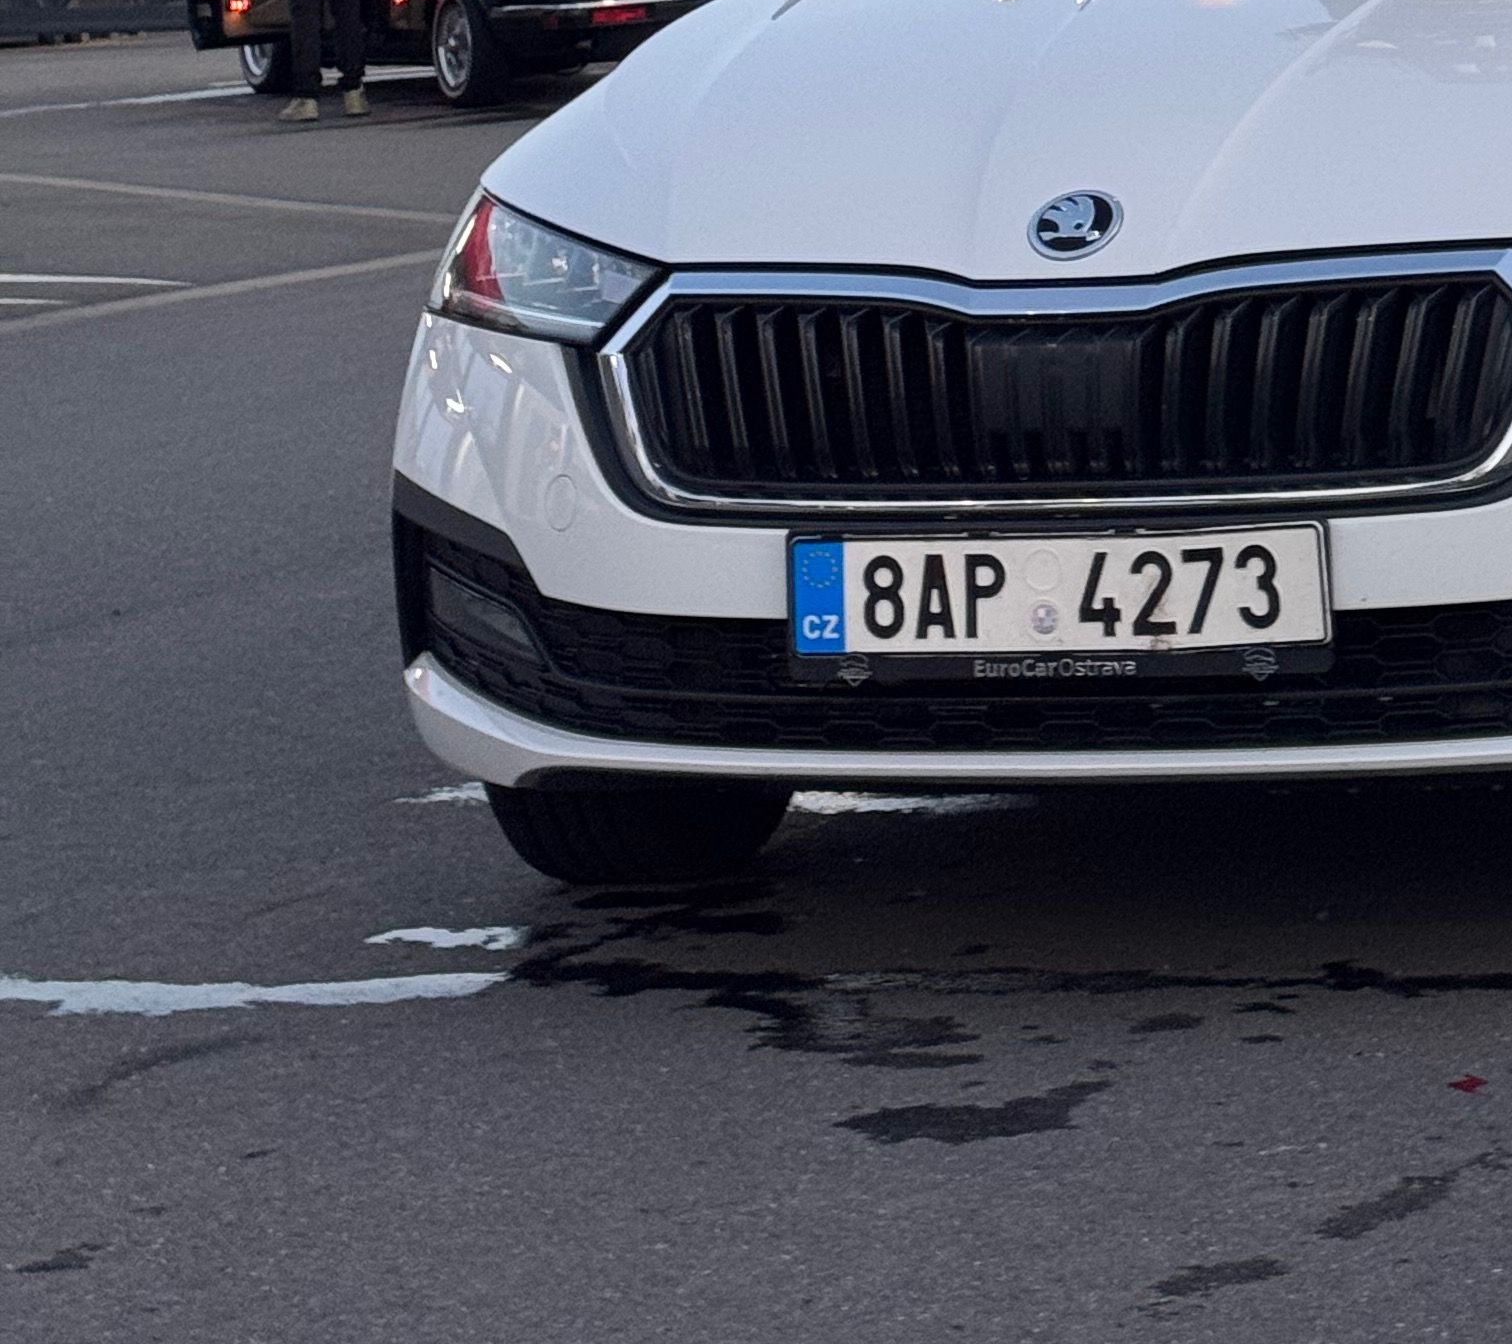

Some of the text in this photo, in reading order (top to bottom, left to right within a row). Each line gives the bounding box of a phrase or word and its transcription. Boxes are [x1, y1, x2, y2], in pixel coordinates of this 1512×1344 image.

[862, 544, 1282, 640] 8AP 4273
[803, 615, 840, 639] CZ
